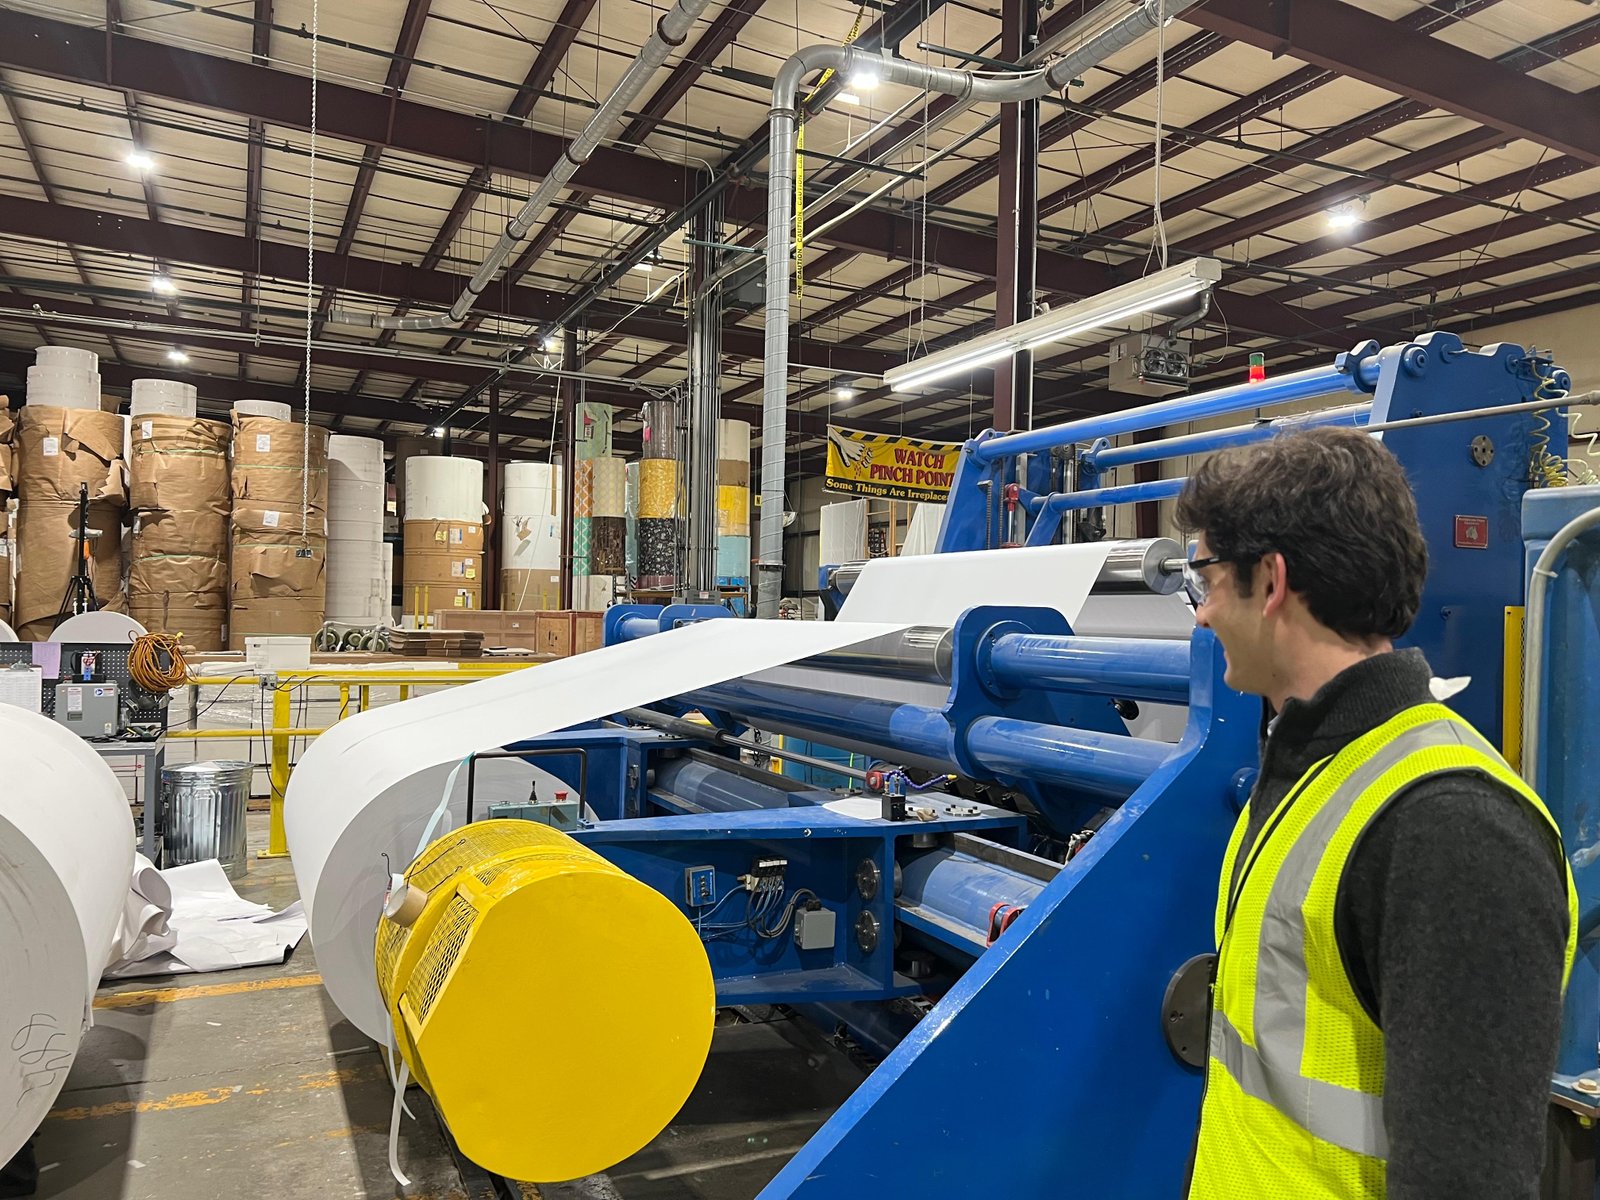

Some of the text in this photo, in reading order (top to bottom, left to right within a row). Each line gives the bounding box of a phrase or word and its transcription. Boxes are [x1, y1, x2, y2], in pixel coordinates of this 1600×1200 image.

[894, 448, 946, 469] WATCH
[870, 464, 913, 484] PINCH
[826, 478, 949, 501] Some Things Are Irreplace
